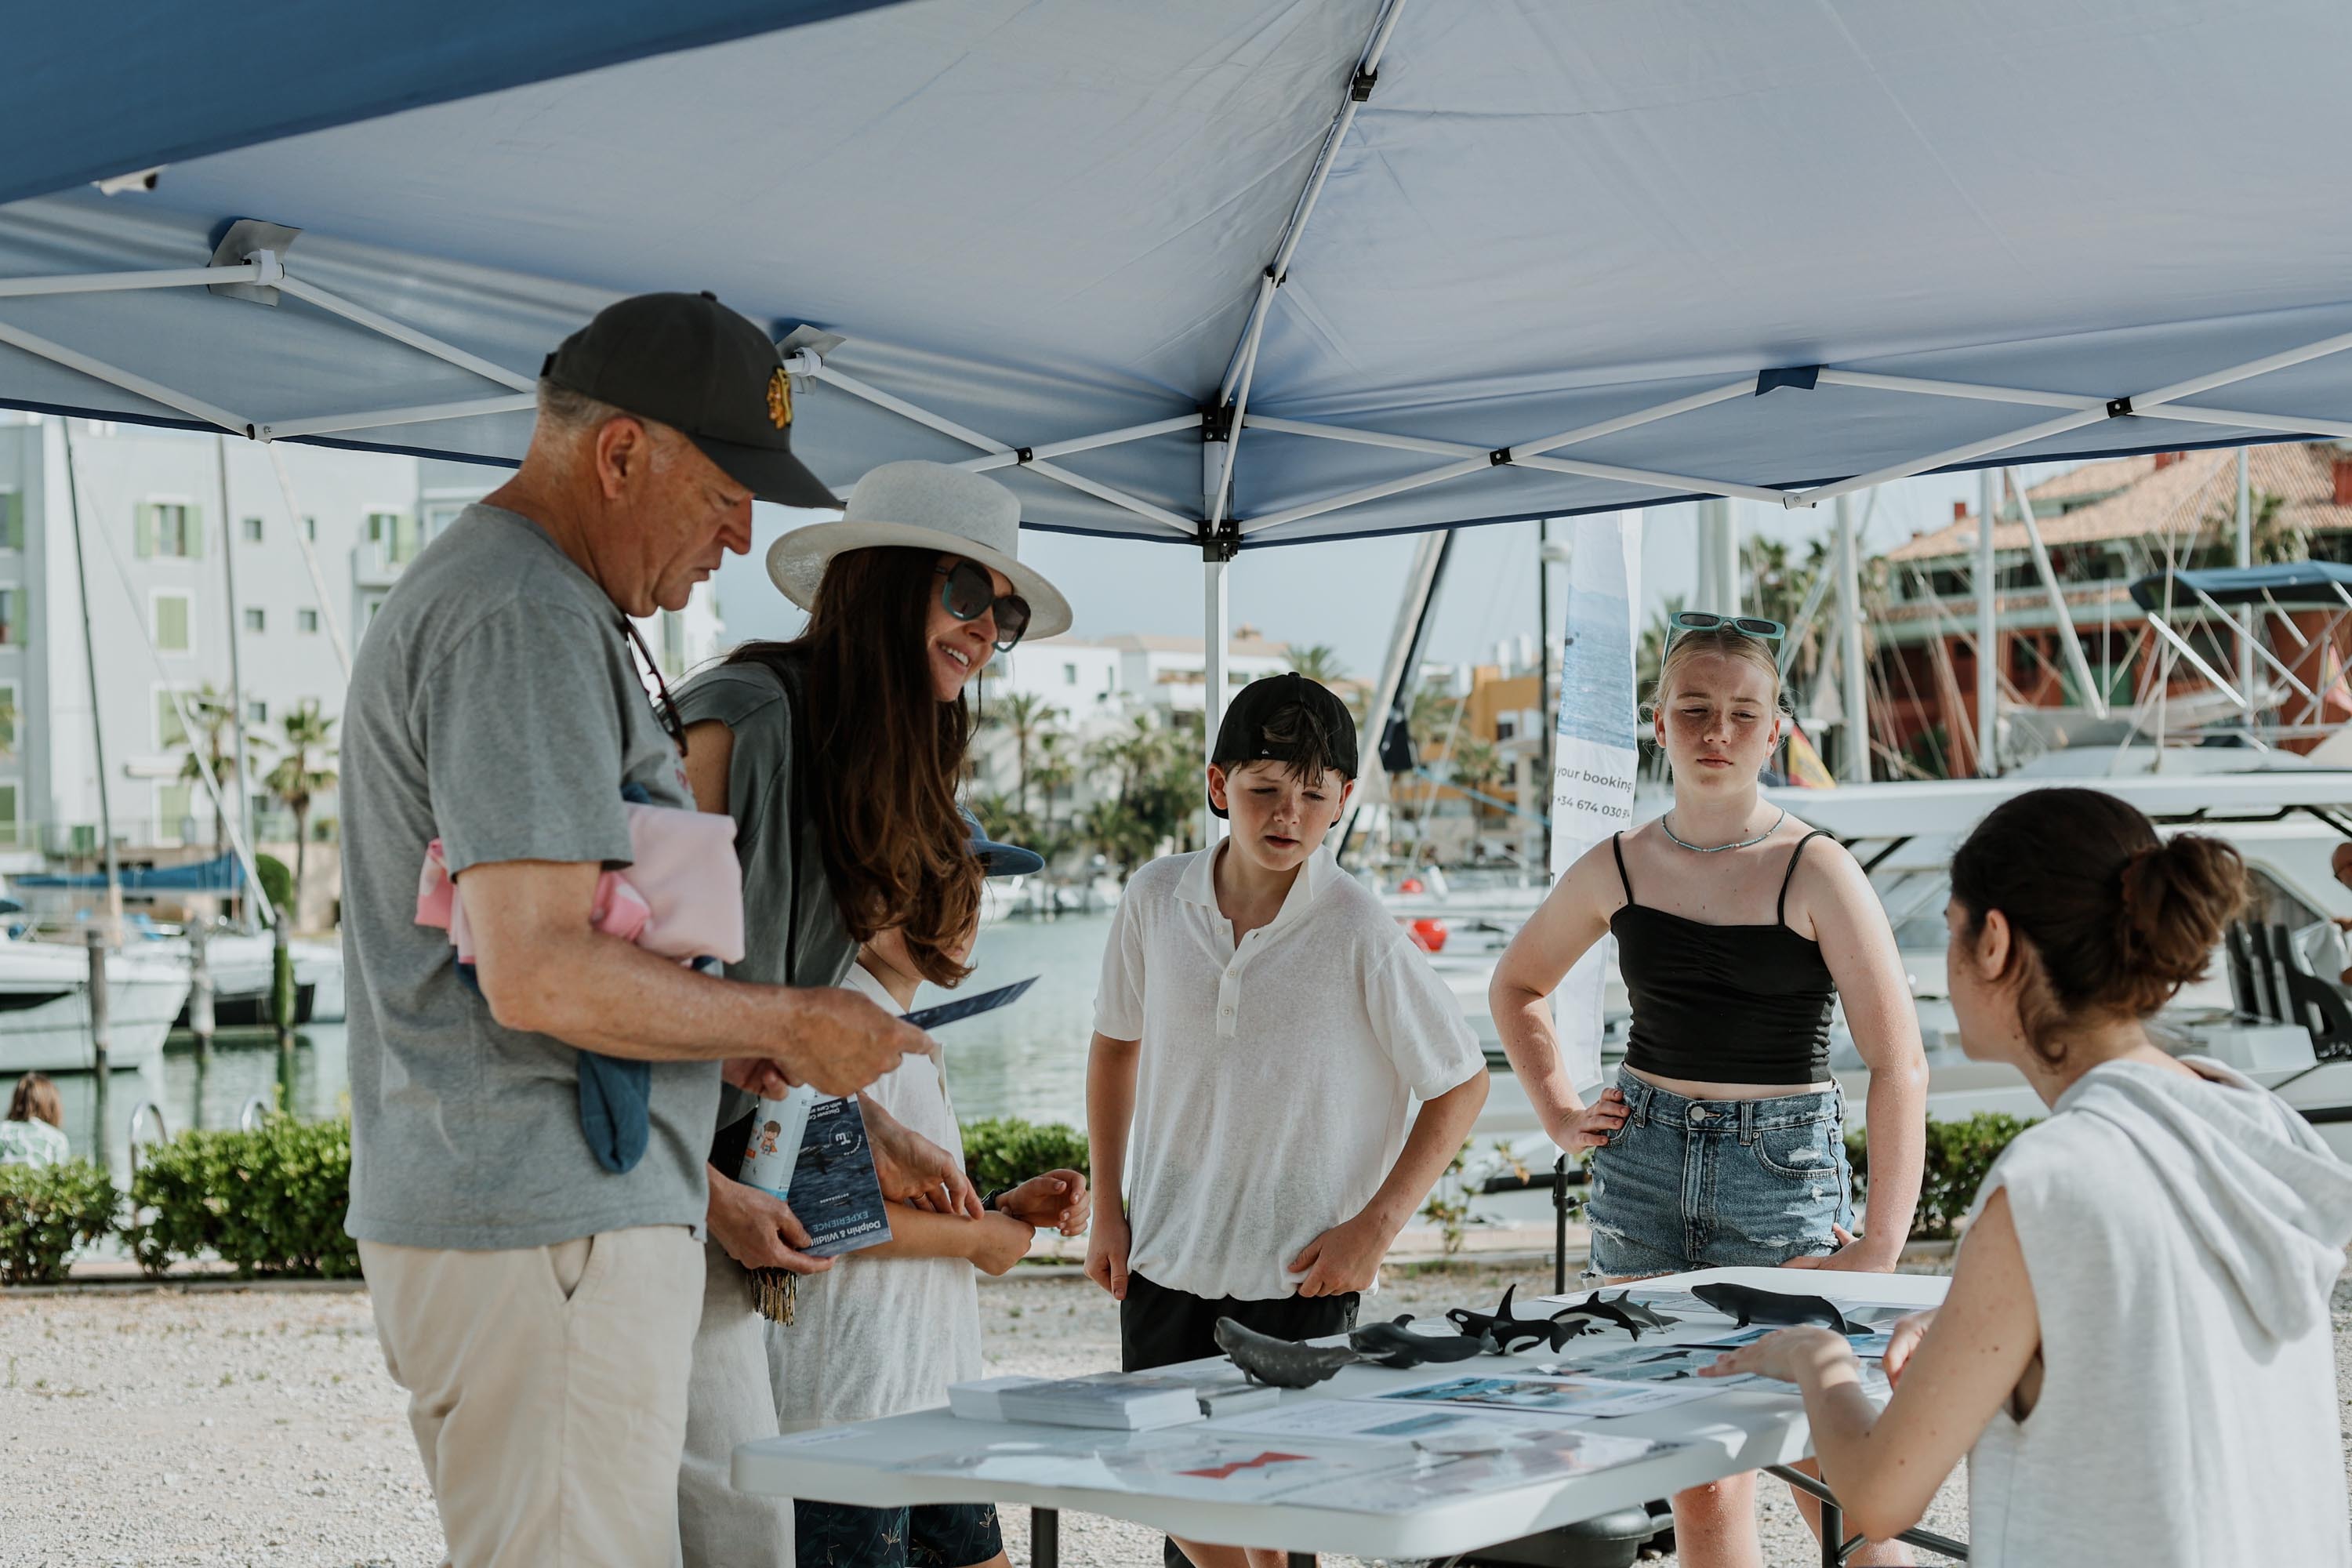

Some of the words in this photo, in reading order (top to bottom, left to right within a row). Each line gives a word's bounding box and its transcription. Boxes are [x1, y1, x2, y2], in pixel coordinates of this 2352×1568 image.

[1556, 767, 1580, 779] your
[1583, 770, 1632, 793] booking
[1557, 795, 1573, 807] +34
[1577, 800, 1599, 812] 674
[813, 1210, 869, 1232] EXPERIENCE
[847, 1220, 881, 1236] Dolphin
[811, 1233, 839, 1247] Wildlif
[840, 1229, 846, 1238] &
